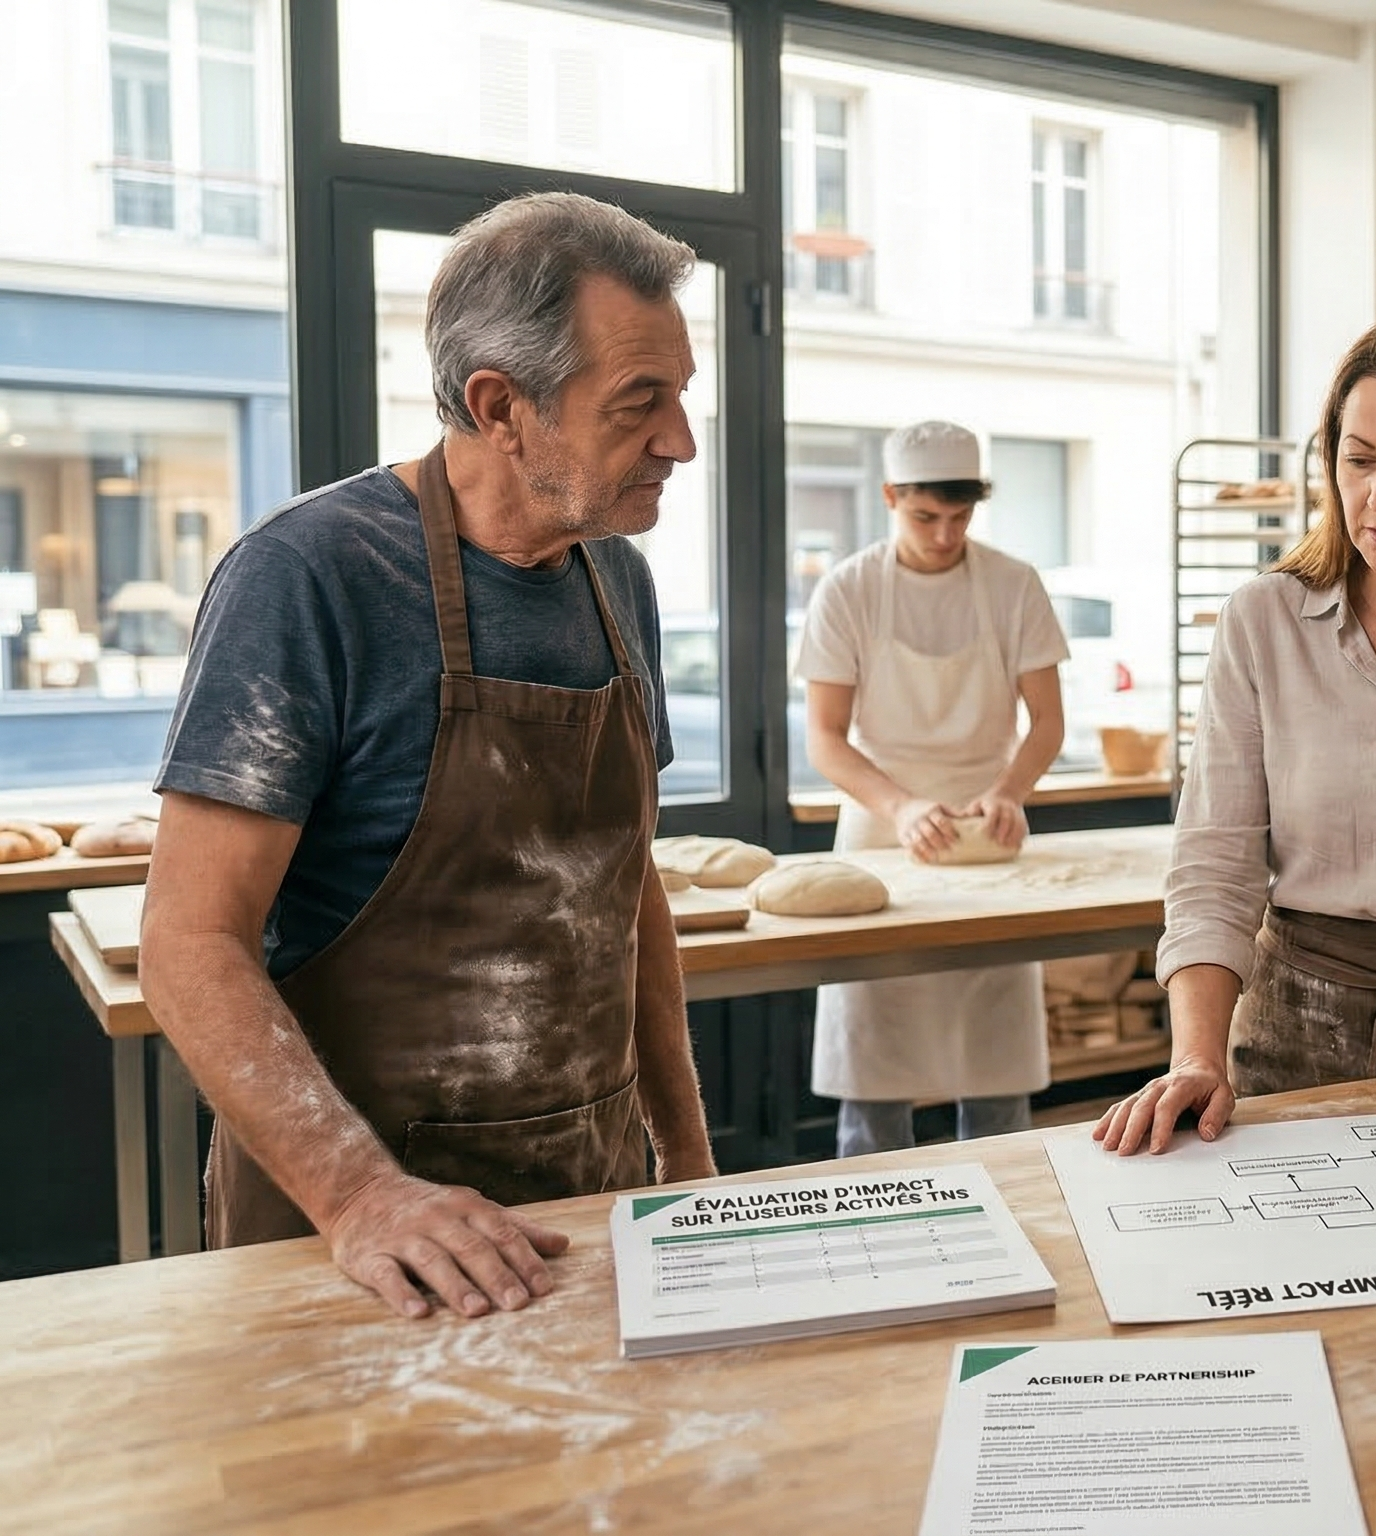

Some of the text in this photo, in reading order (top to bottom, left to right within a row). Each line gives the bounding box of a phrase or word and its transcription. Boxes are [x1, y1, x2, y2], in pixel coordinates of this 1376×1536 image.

[671, 1188, 970, 1228] SUR PLUSEURS ACTIVÉS TNS
[694, 1178, 935, 1212] ÉVALUATION D'IMPACT
[1109, 1373, 1131, 1383] DE
